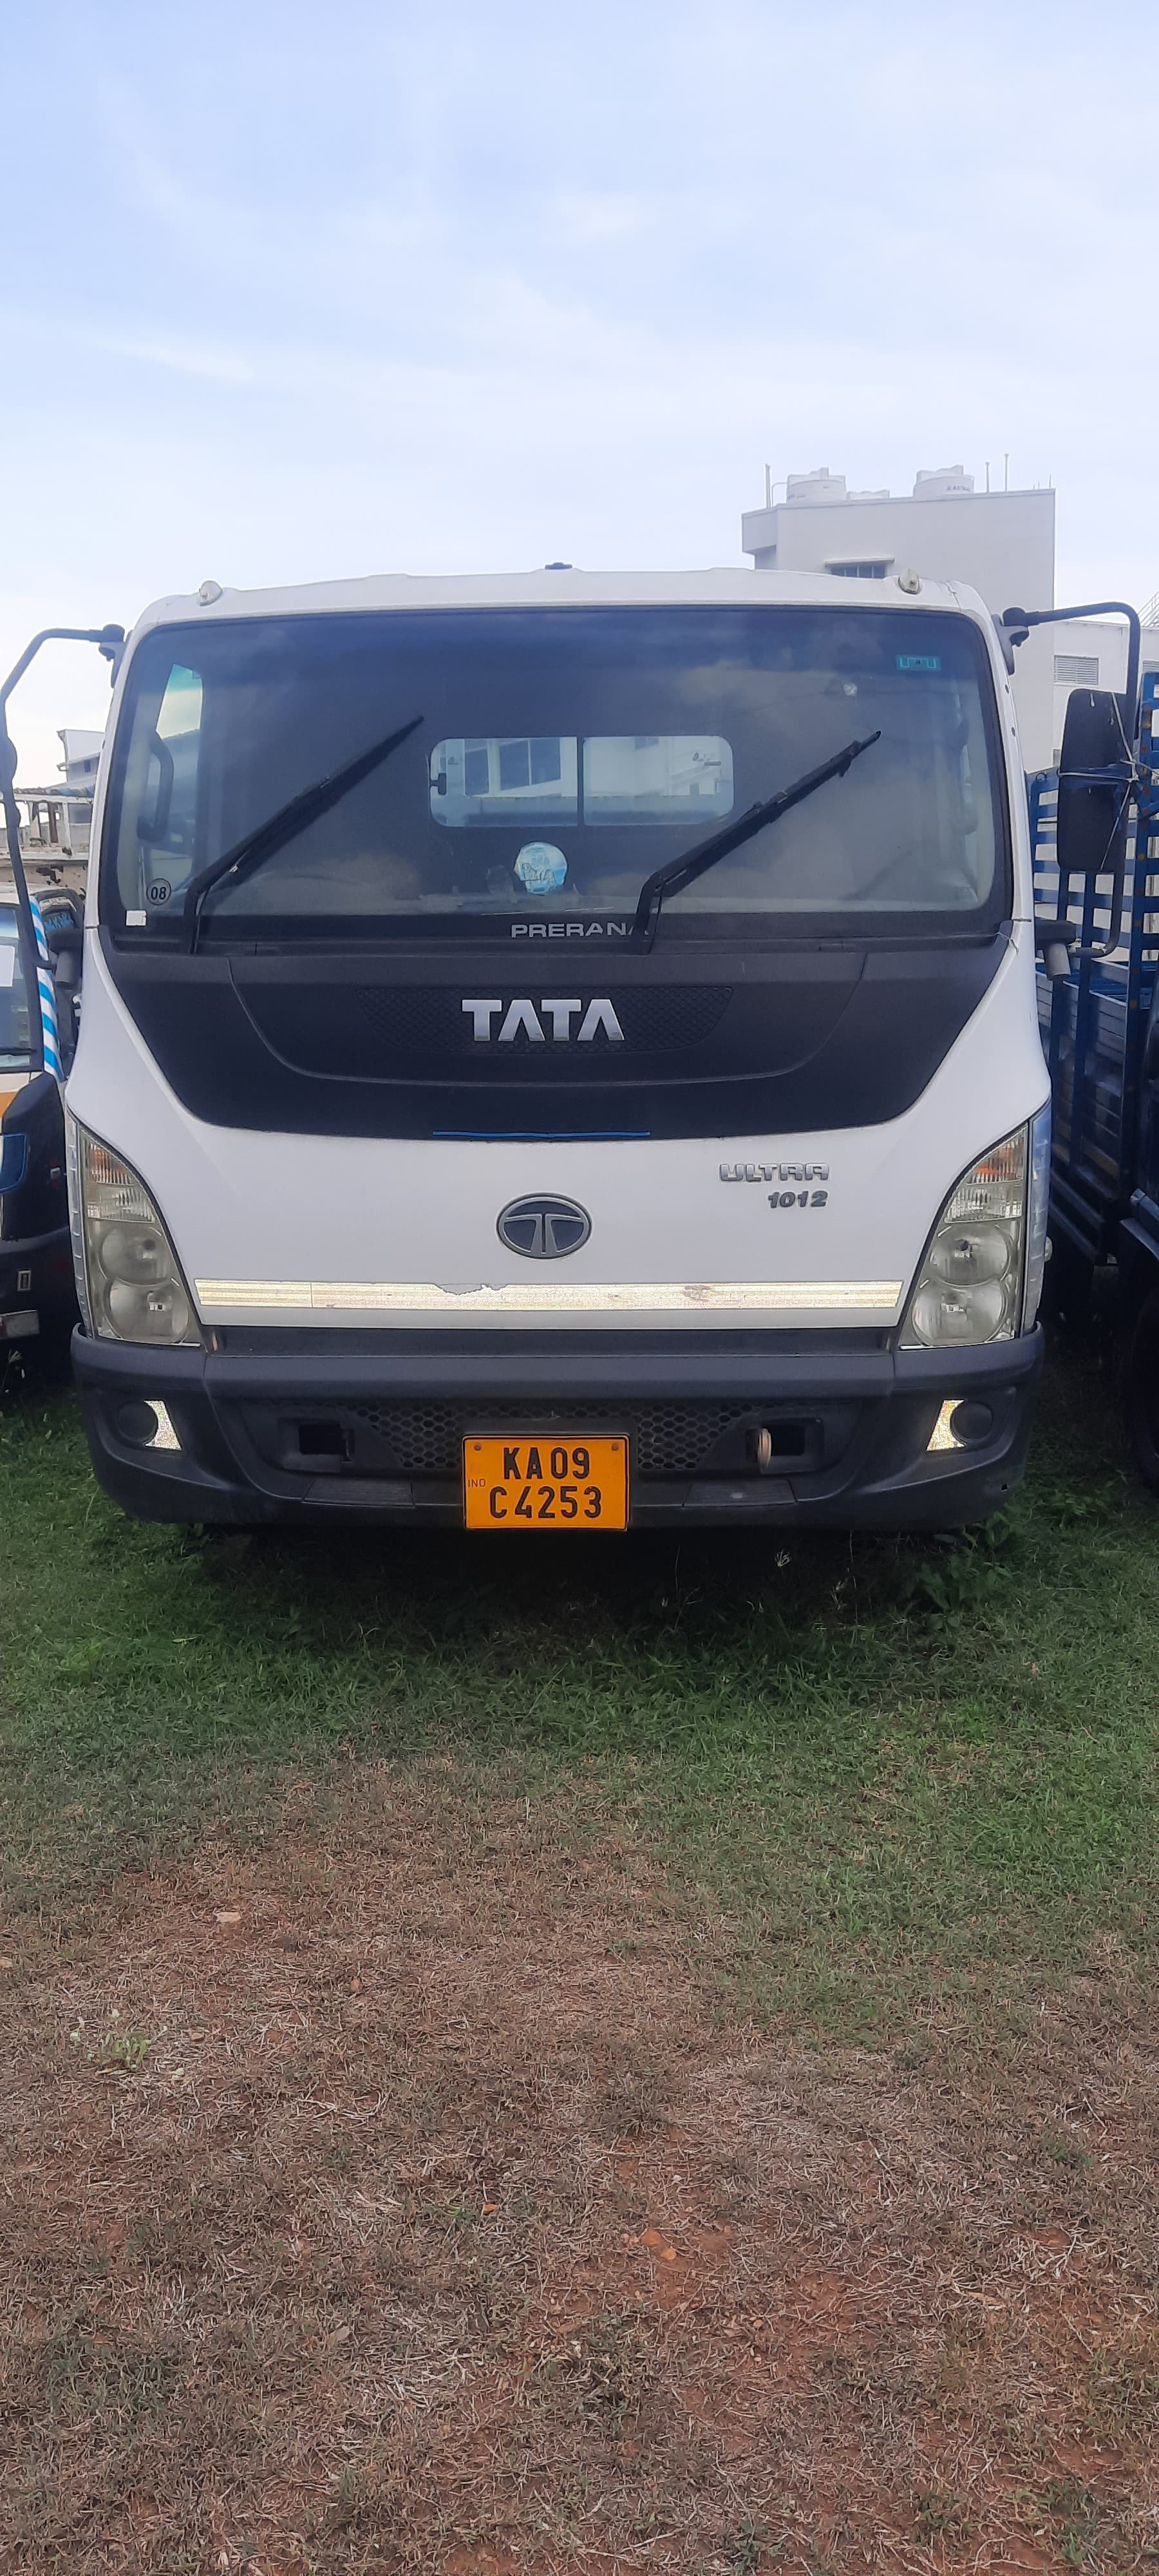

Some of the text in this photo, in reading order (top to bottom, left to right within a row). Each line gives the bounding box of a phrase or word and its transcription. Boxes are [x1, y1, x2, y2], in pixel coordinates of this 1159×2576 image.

[151, 886, 166, 900] 08
[511, 922, 648, 938] PRERAN
[462, 999, 625, 1041] TATA
[720, 1163, 829, 1181] ULTRA
[768, 1191, 828, 1208] 1012
[504, 1447, 590, 1480] KA09
[468, 1478, 486, 1488] IND
[489, 1486, 601, 1519] C4253
